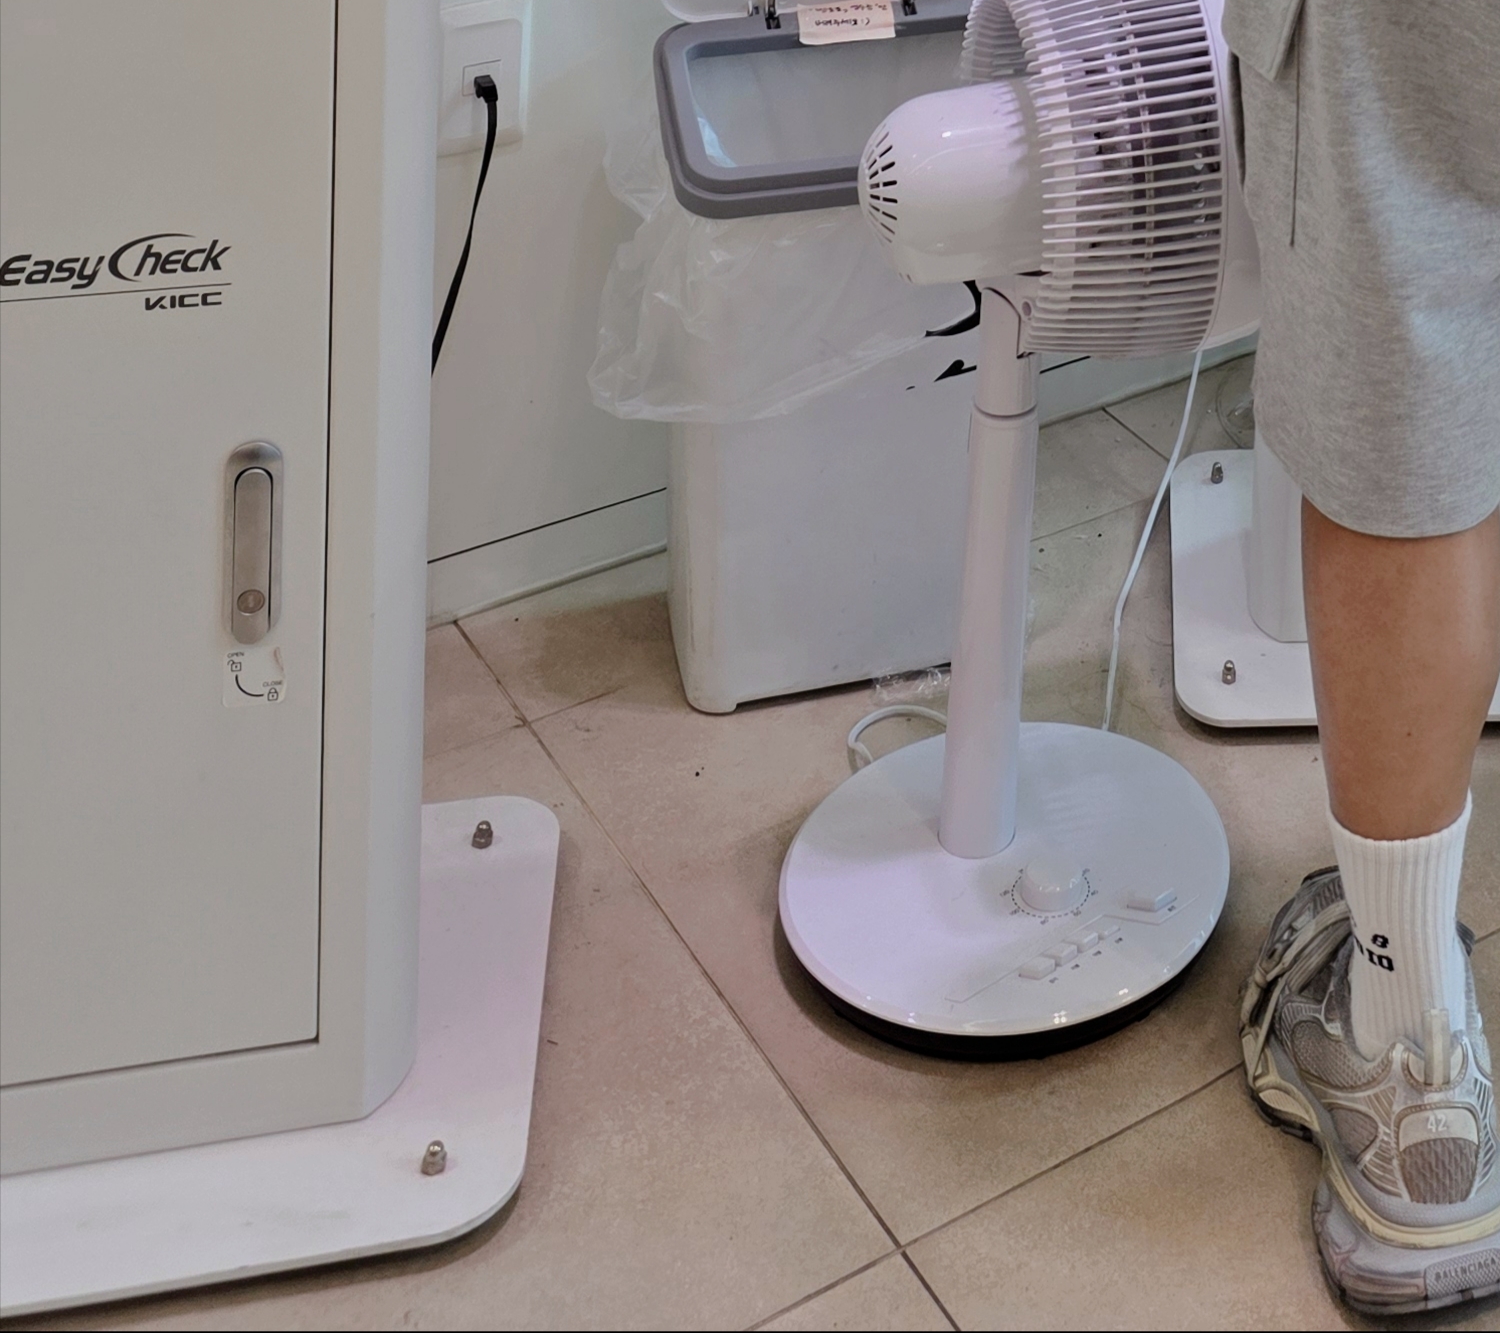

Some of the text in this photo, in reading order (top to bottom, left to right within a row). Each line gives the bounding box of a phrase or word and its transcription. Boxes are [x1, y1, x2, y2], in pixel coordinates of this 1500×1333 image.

[145, 292, 222, 311] KICC
[1427, 1114, 1448, 1132] 42
[1434, 1257, 1498, 1283] BALENCIAGA
